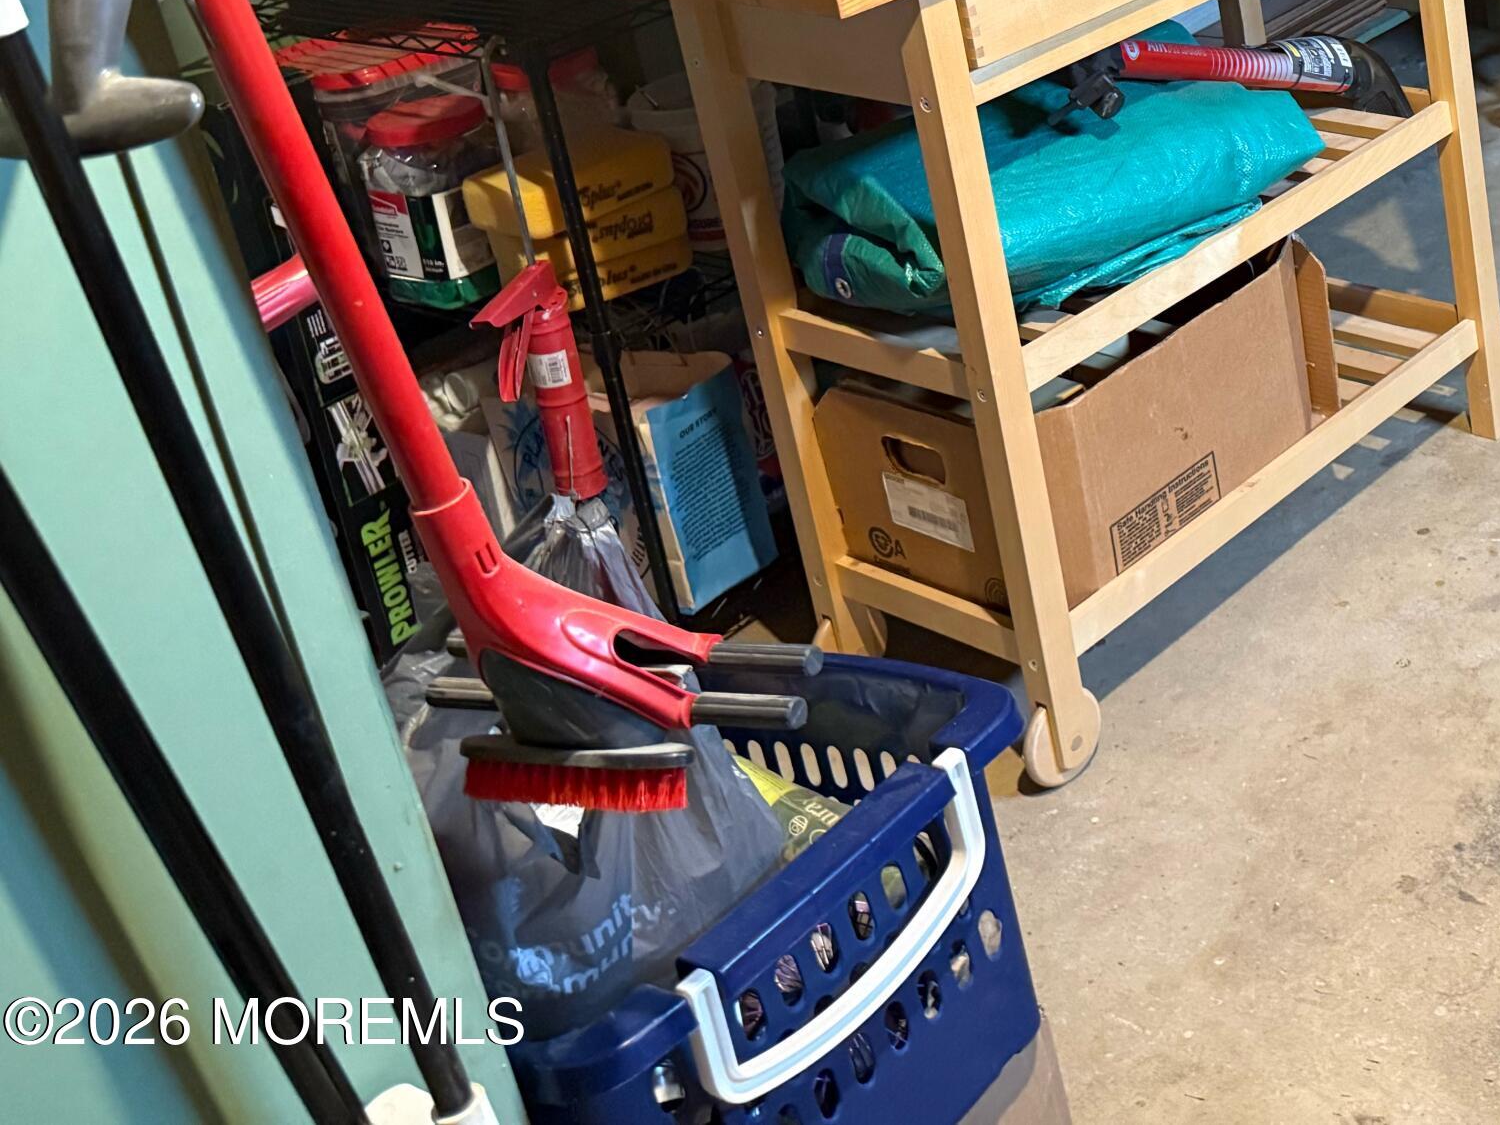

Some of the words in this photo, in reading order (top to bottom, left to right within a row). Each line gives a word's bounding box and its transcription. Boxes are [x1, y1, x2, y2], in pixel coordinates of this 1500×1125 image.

[1117, 515, 1134, 531] Safe
[1168, 459, 1209, 494] Instructions
[361, 508, 421, 647] PROWLER
